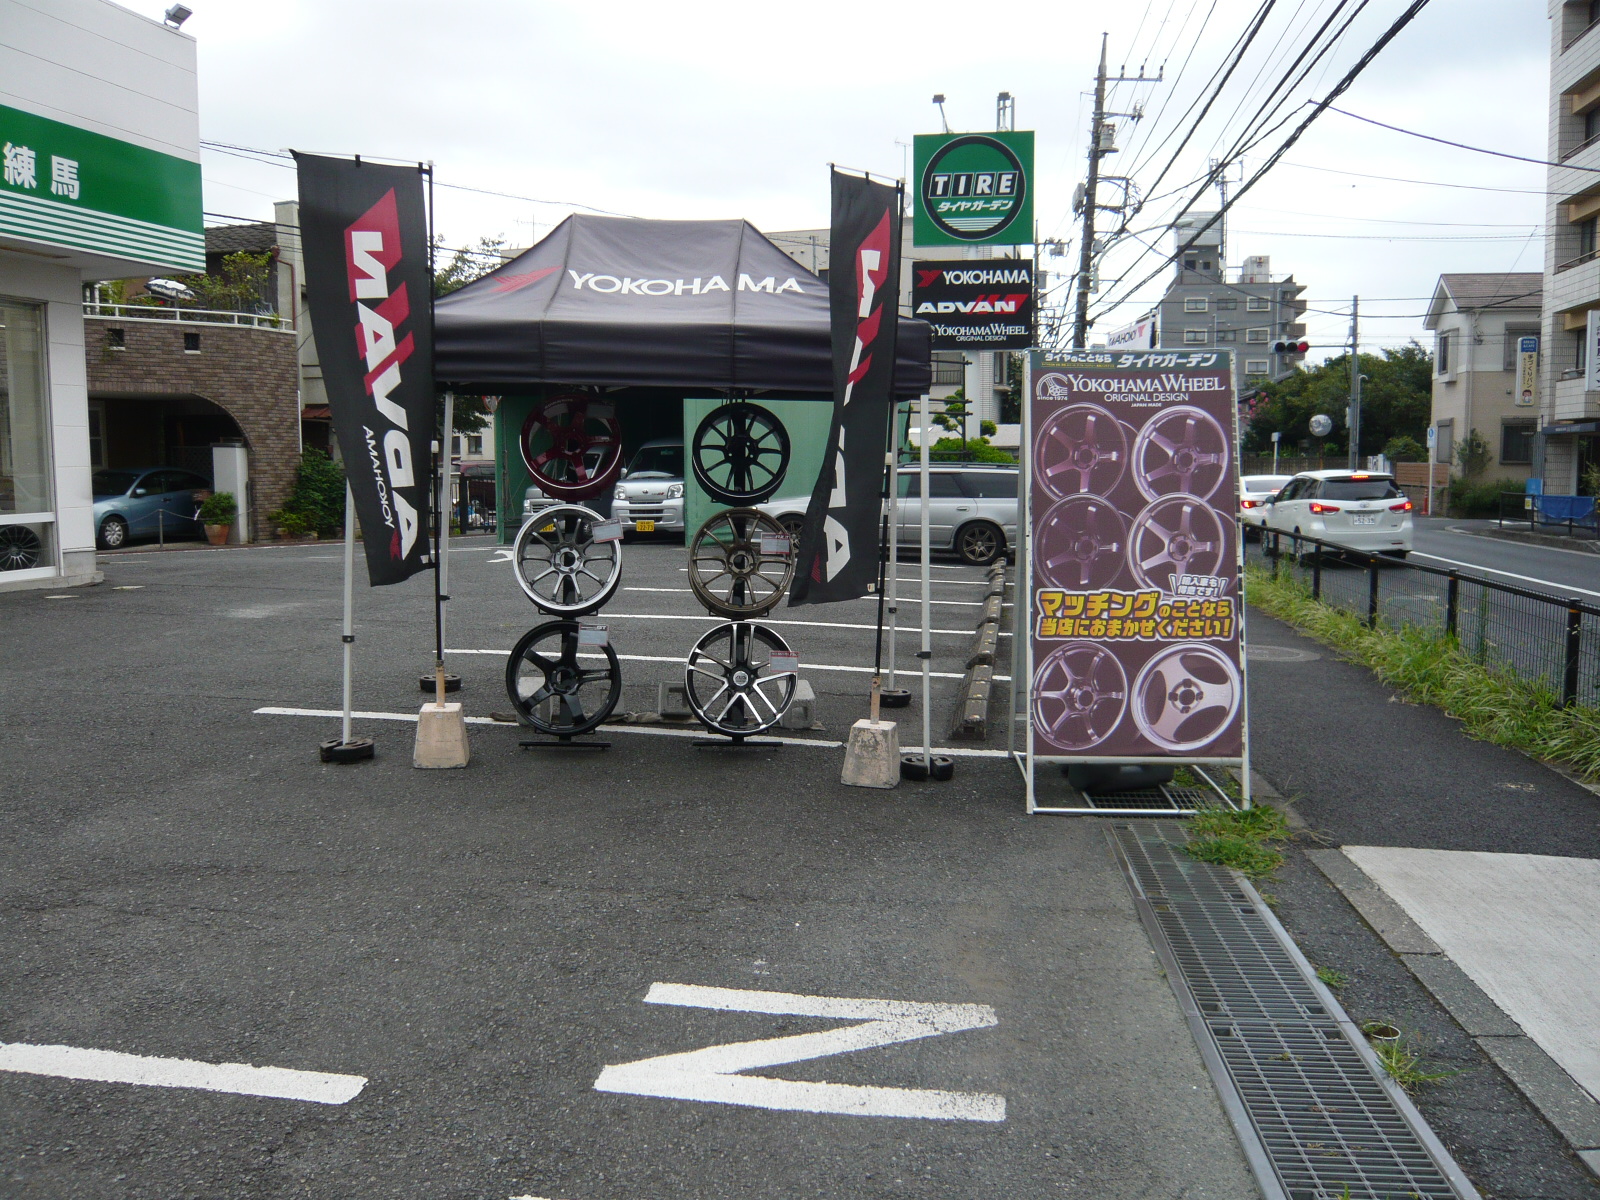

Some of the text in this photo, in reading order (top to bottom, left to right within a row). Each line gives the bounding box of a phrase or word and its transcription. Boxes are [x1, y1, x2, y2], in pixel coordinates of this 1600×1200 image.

[3, 141, 80, 200] 練馬
[935, 174, 1013, 196] TIRE
[937, 199, 1014, 212] タイヤガーデン
[568, 269, 806, 295] YOKOHAMA
[943, 269, 1030, 285] YOKOHAMA
[916, 301, 1015, 314] ADVAN
[935, 323, 1028, 336] YOKOHAMA WHEEL
[1045, 353, 1112, 363] タイヤのことなら
[1116, 353, 1217, 368] タイヤガーデン
[1067, 373, 1226, 392] YOKOHAMA WHEEL
[1104, 393, 1189, 402] ORIGINAL DESIGN
[1040, 592, 1230, 618] マッチングのことなら
[1040, 618, 1231, 637] 当店におまかせください!
